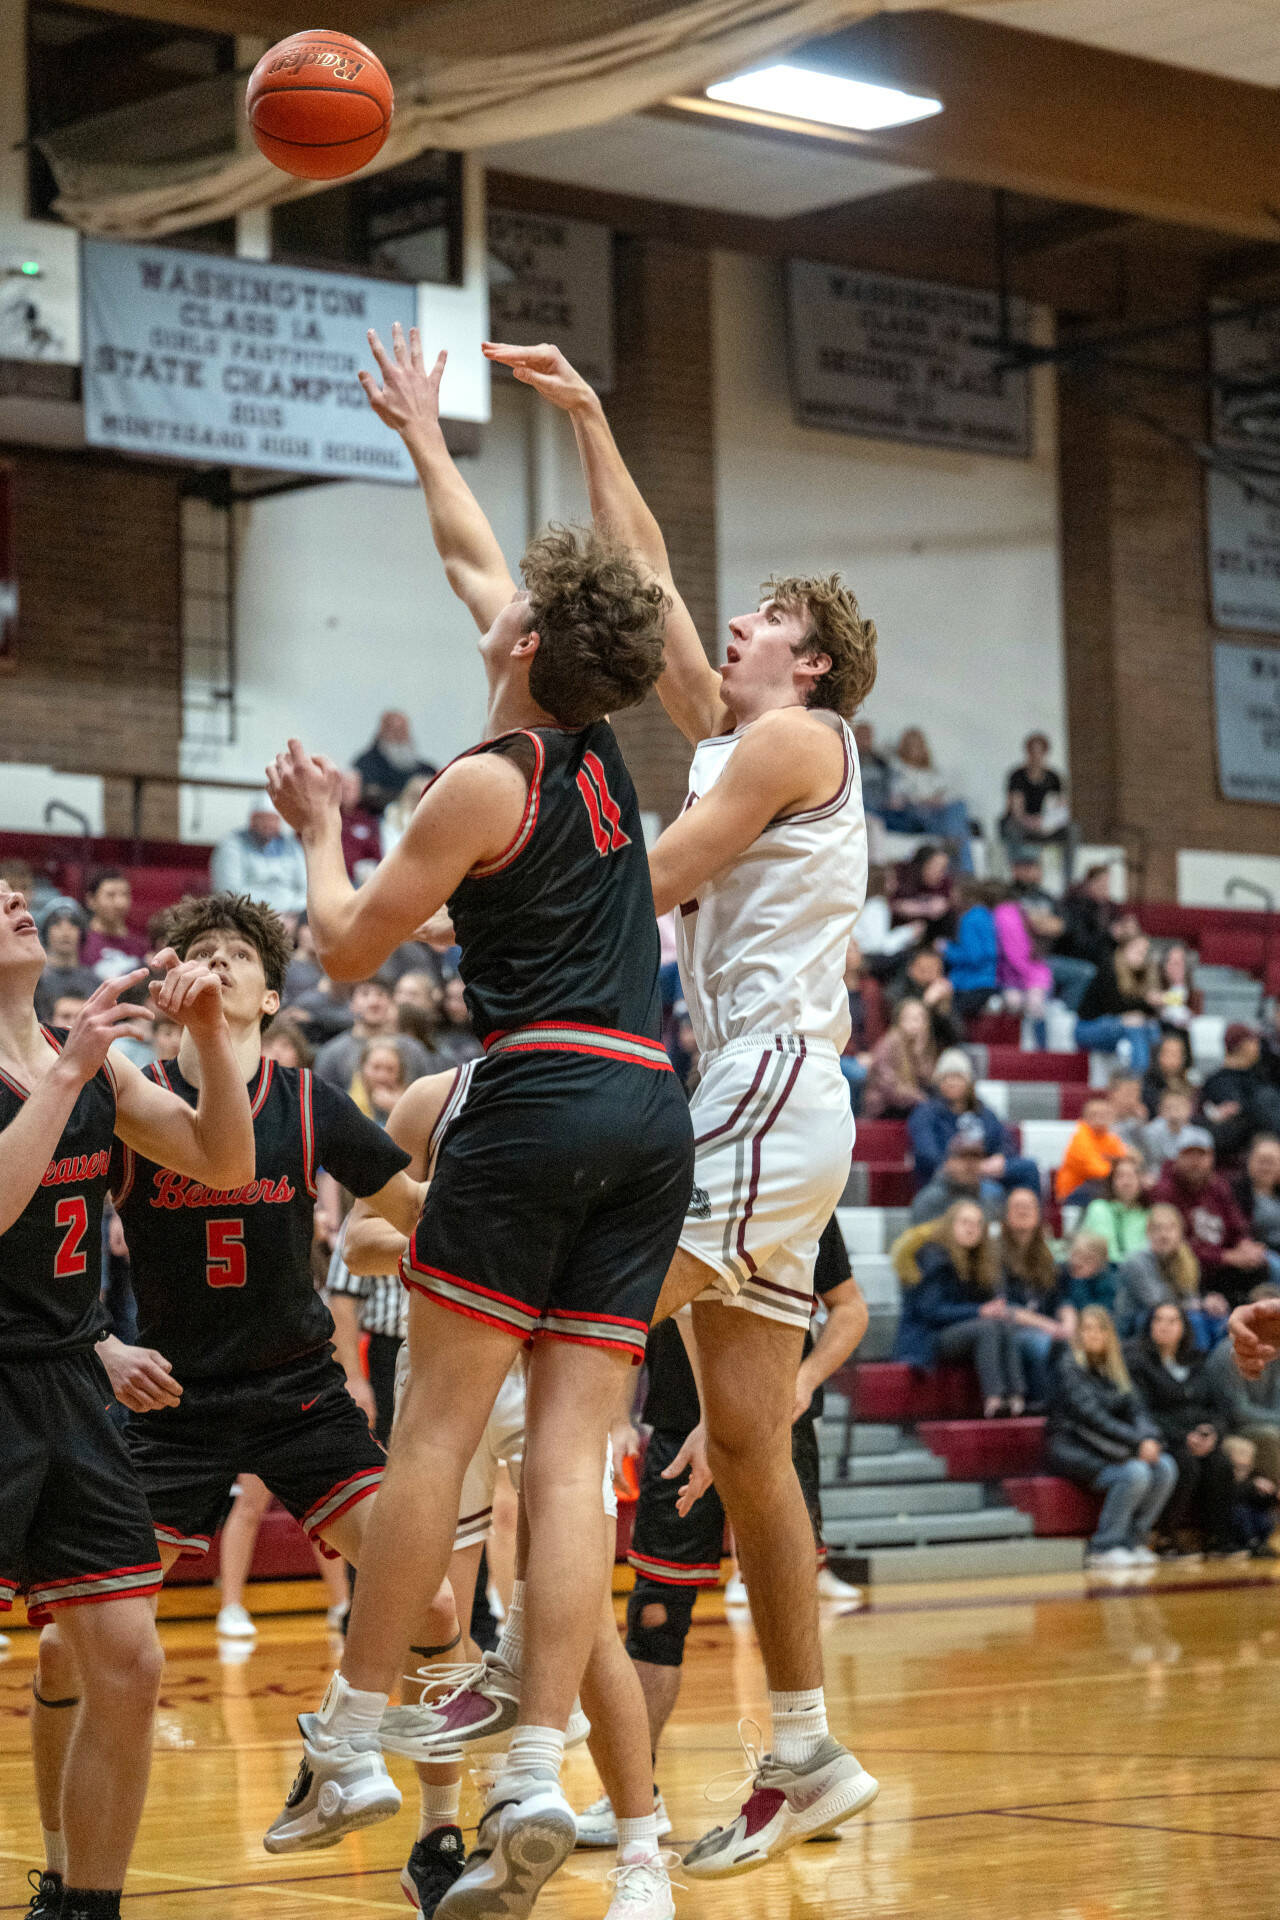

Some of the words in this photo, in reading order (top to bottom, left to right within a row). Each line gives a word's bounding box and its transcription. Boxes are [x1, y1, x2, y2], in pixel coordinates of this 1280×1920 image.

[138, 258, 367, 319] WASHINGTON
[178, 300, 279, 338] CLASS
[95, 342, 205, 389] STATE
[222, 364, 374, 409] CHAMPIO
[576, 750, 632, 857] 11
[40, 1146, 112, 1187] eaver
[150, 1168, 295, 1210] Beavers
[54, 1195, 88, 1279] 2
[206, 1218, 247, 1289] 5
